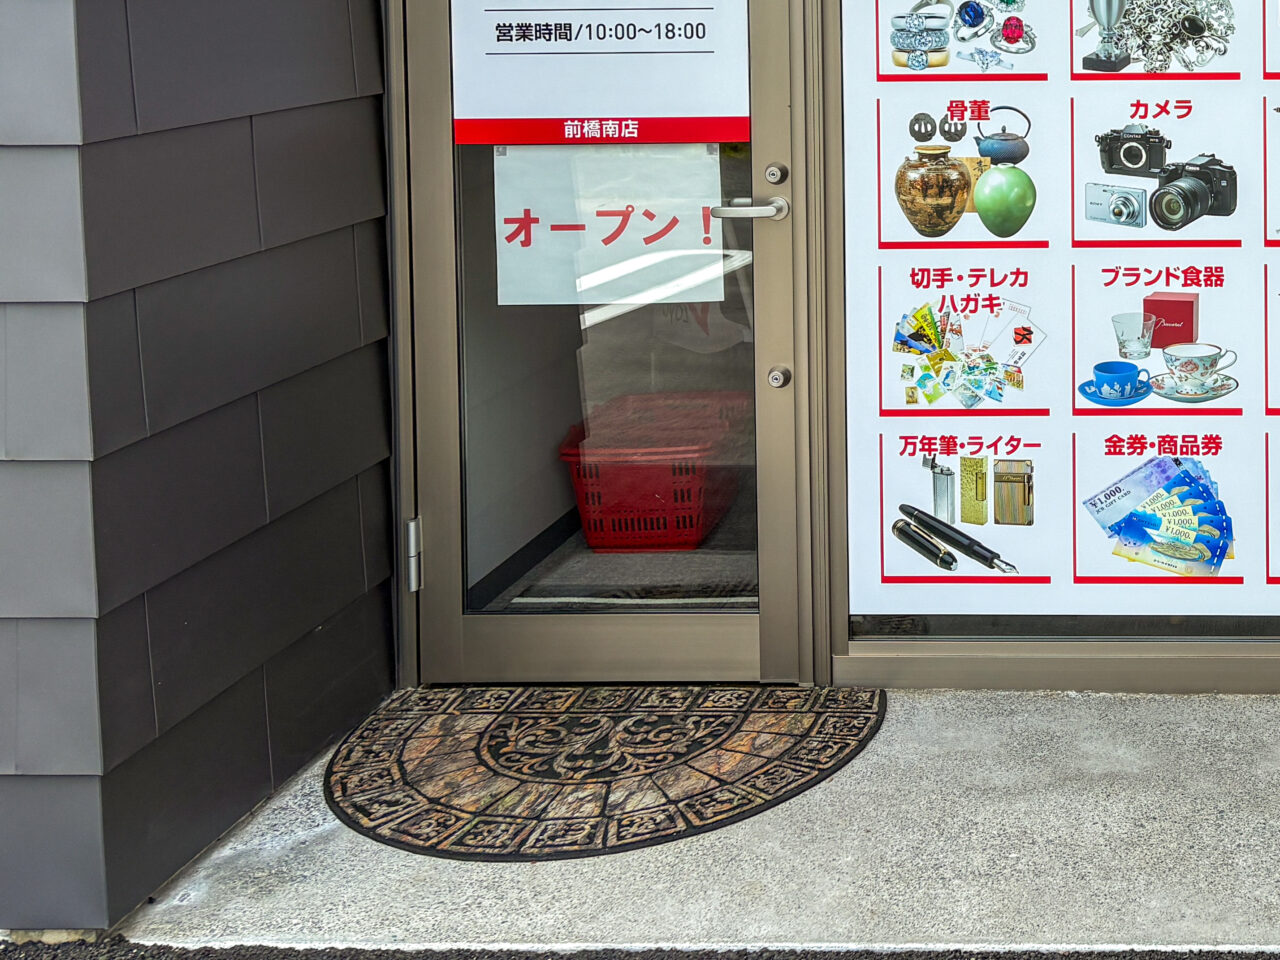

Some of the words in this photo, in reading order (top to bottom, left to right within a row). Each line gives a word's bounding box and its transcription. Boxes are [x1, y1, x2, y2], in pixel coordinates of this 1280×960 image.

[947, 100, 990, 122] 骨董
[1130, 99, 1193, 120] カメラ
[563, 120, 639, 138] 前橋南店
[910, 267, 1029, 289] 切手・テレカ
[1100, 265, 1225, 288] ブランド食器
[938, 293, 1002, 315] ハガキ
[898, 435, 1042, 457] 万年筆・ライター
[1104, 434, 1223, 456] 金券・商品券
